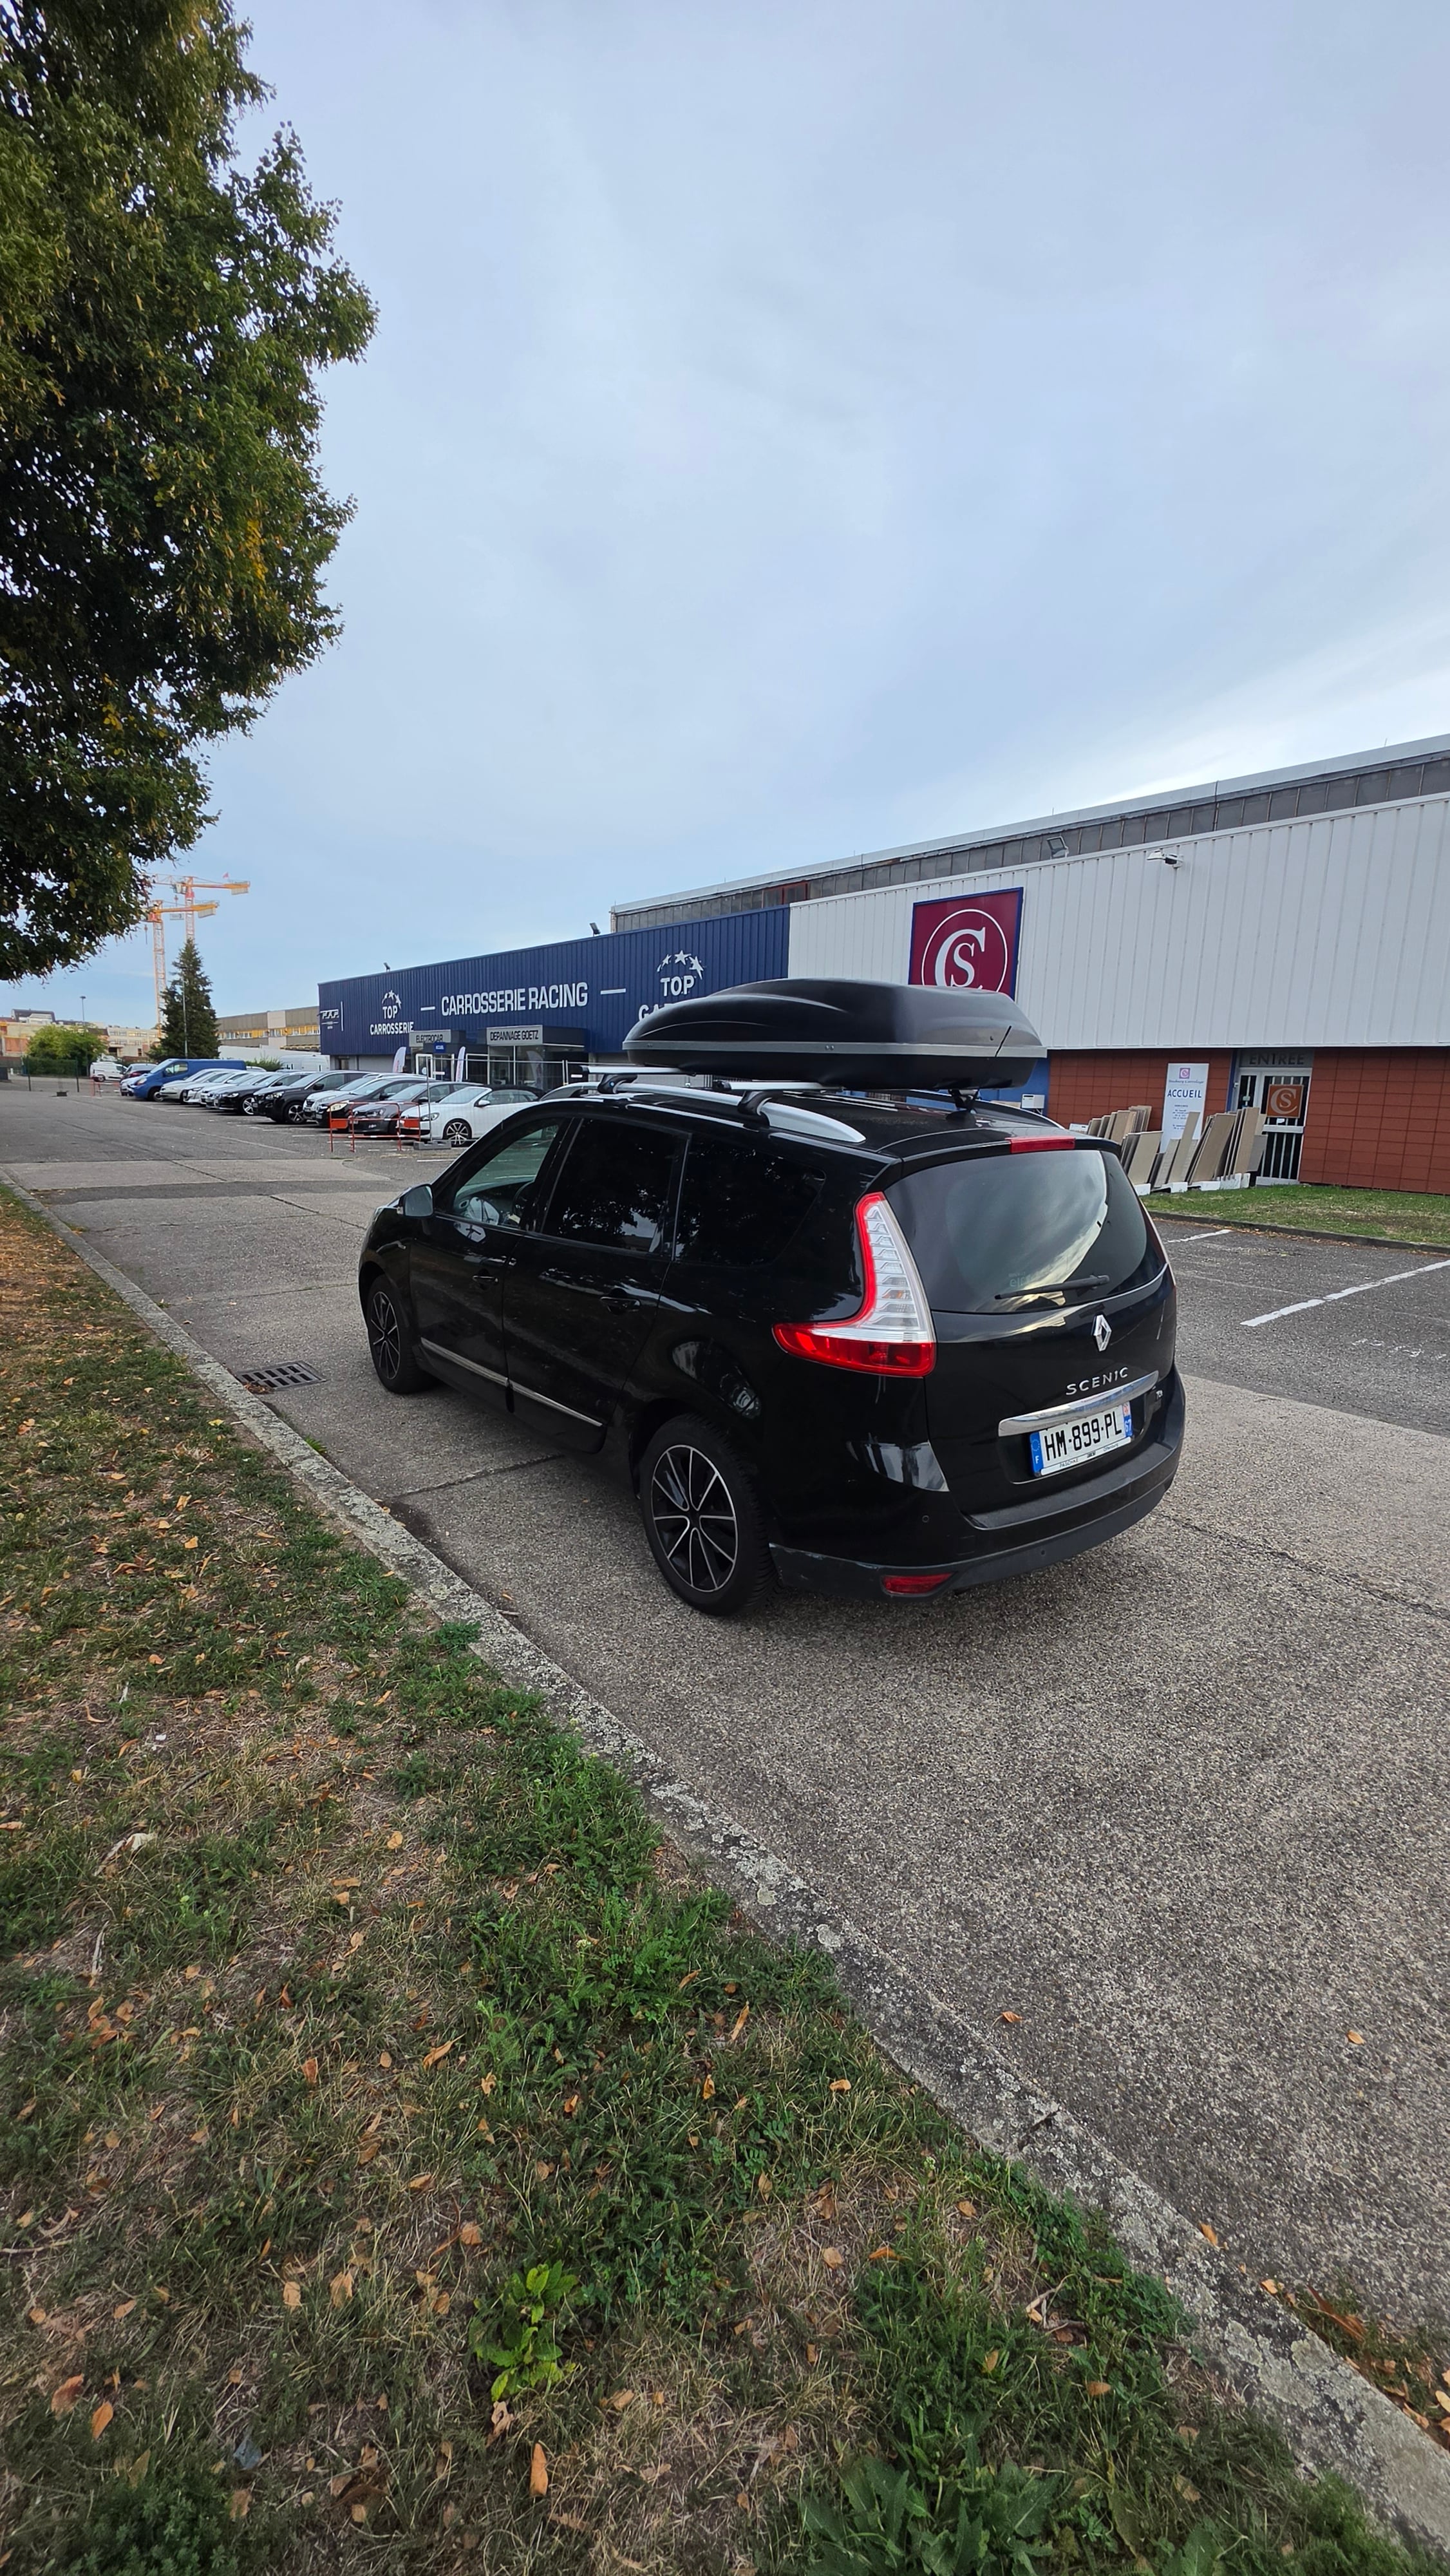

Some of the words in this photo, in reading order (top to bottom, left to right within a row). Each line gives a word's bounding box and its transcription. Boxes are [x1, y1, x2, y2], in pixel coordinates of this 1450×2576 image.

[660, 975, 694, 996] TOP
[442, 989, 525, 1016] CARROSSERIE
[529, 982, 588, 1010] RACING
[382, 1005, 398, 1019] TOP
[370, 1021, 414, 1036] CARROSSERIE
[490, 1030, 521, 1041] DEPANNAGE
[522, 1030, 539, 1040] GOETZ
[1167, 1089, 1201, 1098] ACCUEIL
[1066, 1367, 1128, 1396] SCENIC
[1044, 1411, 1122, 1461] HM-899-PL
[1035, 1455, 1040, 1464] F
